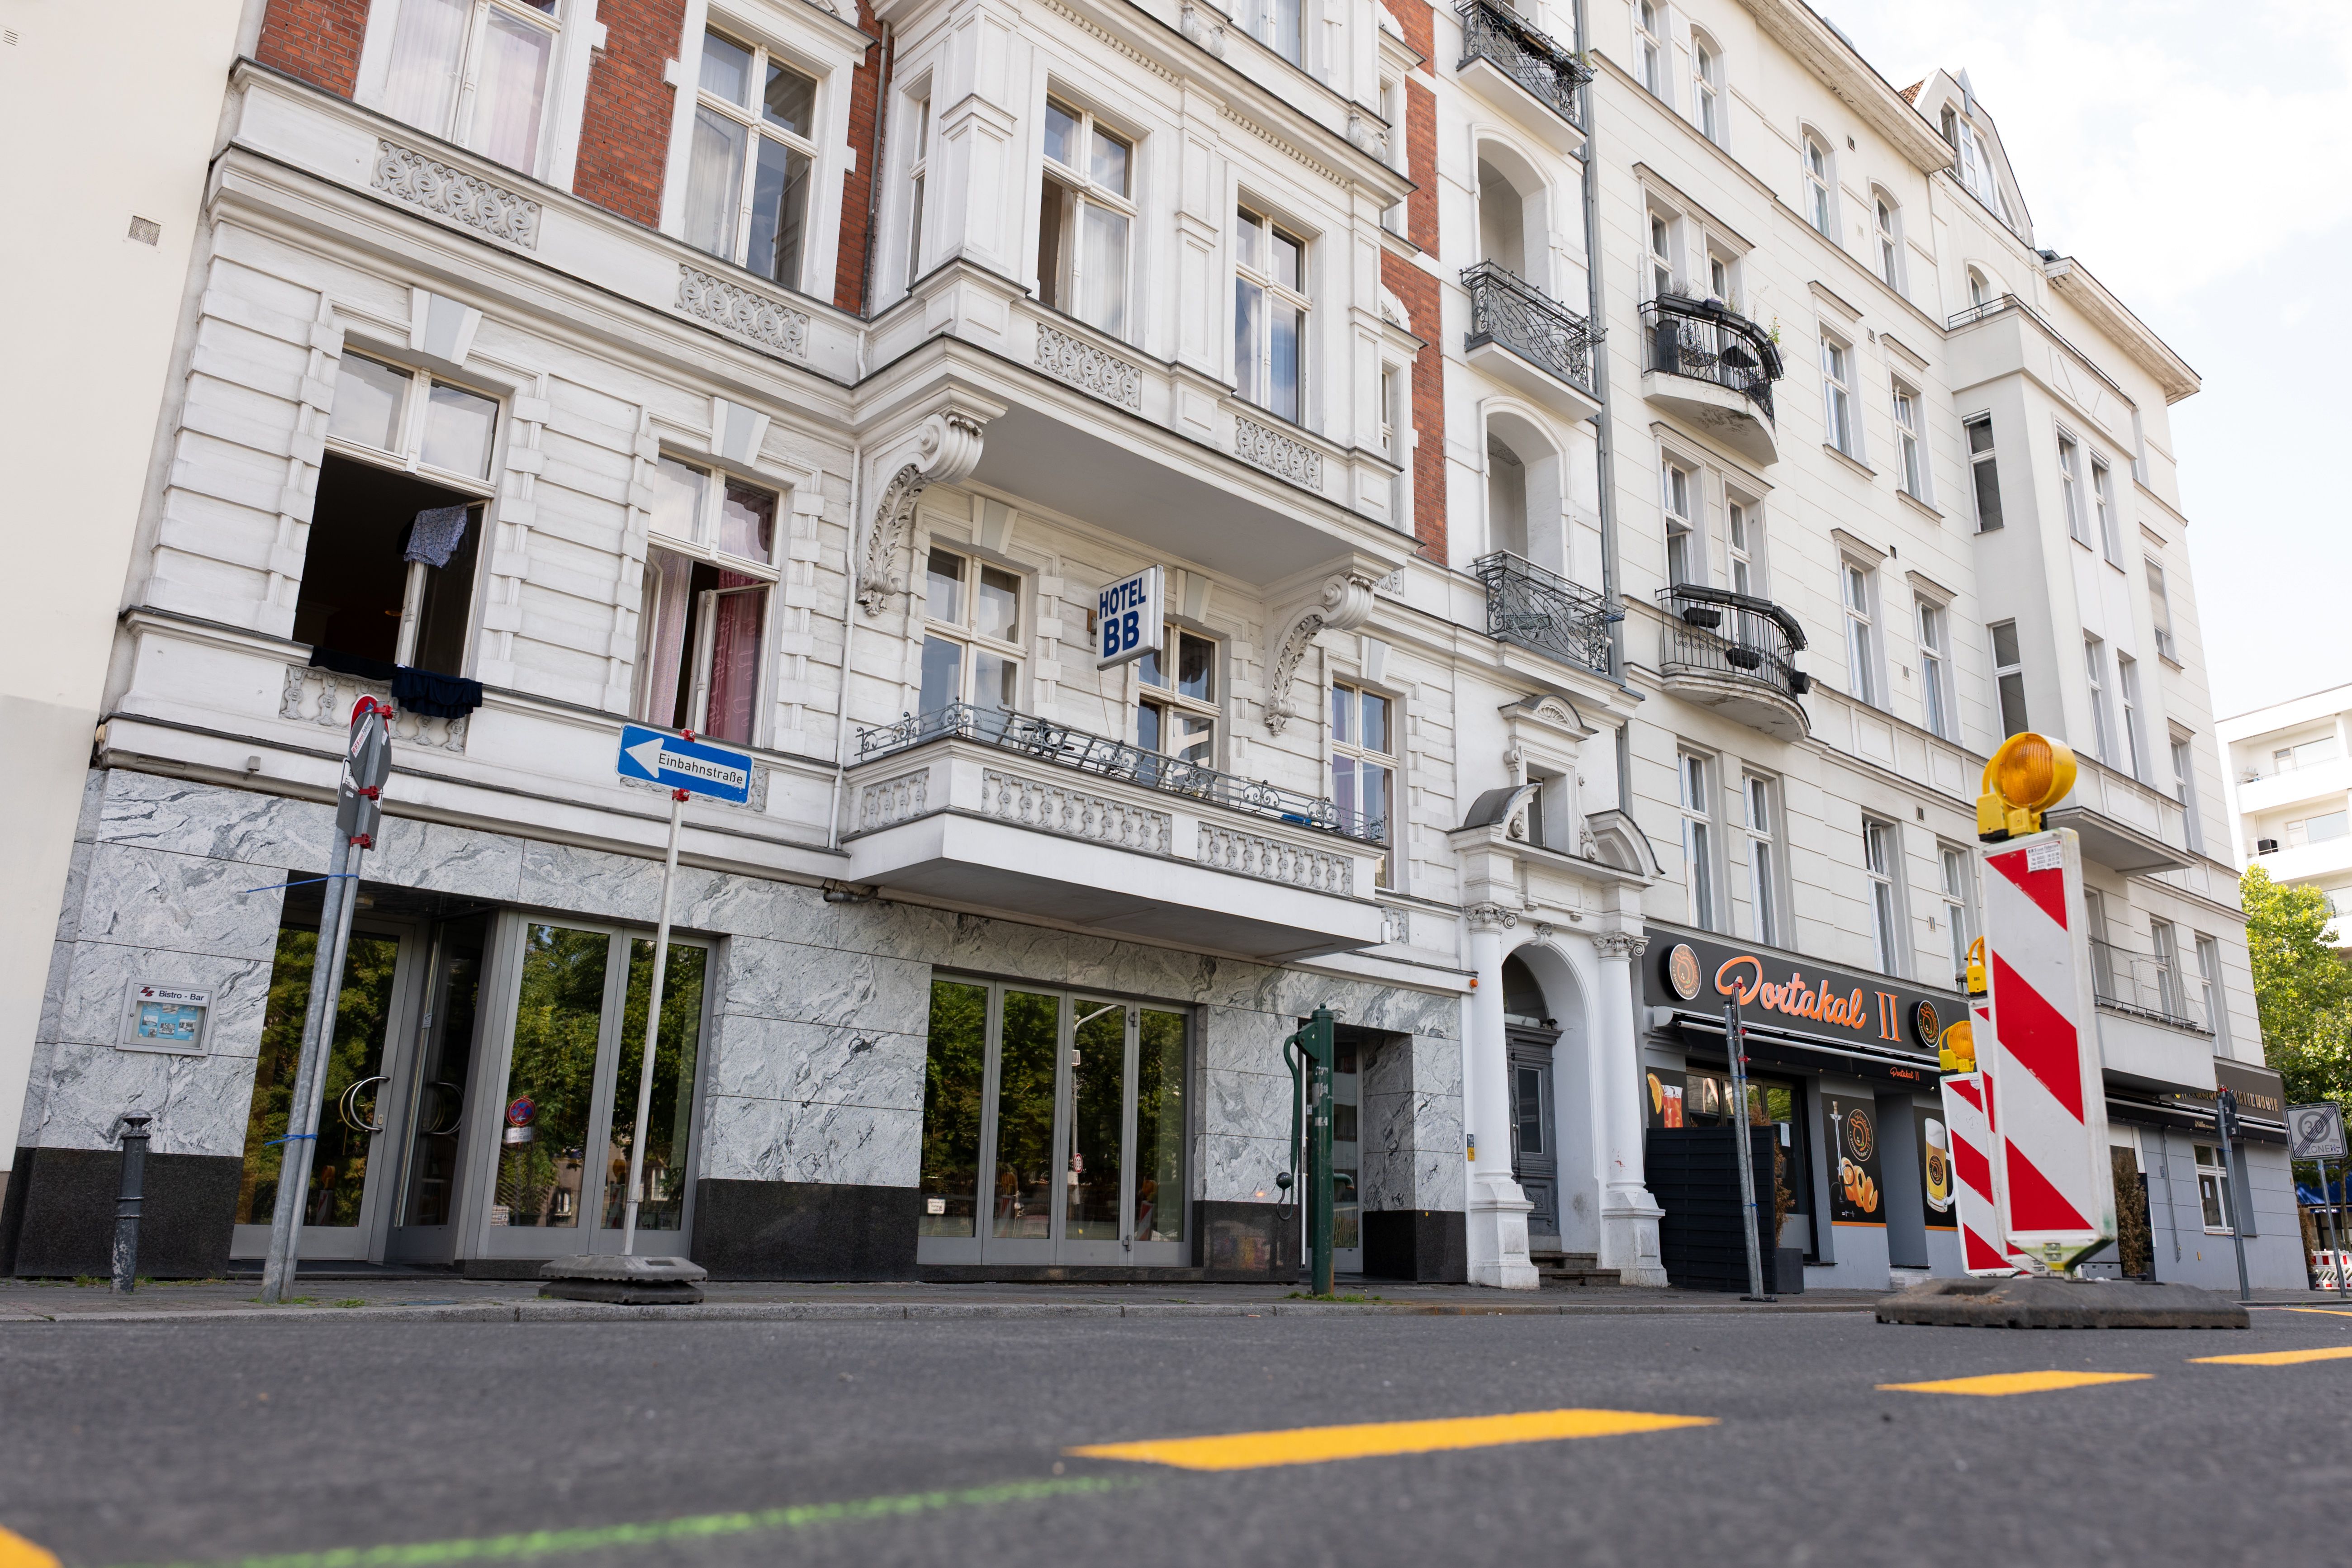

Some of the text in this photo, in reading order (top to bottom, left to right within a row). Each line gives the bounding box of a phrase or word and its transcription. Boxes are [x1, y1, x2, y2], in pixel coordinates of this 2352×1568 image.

[1099, 577, 1146, 620] HOTEL
[1104, 611, 1139, 658] BB
[659, 753, 743, 784] Einbahnstraße
[159, 990, 182, 999] Bistro
[1715, 956, 1902, 1042] Portakal II
[1890, 1067, 1914, 1079] Portakal
[2307, 1145, 2330, 1154] ZONE
